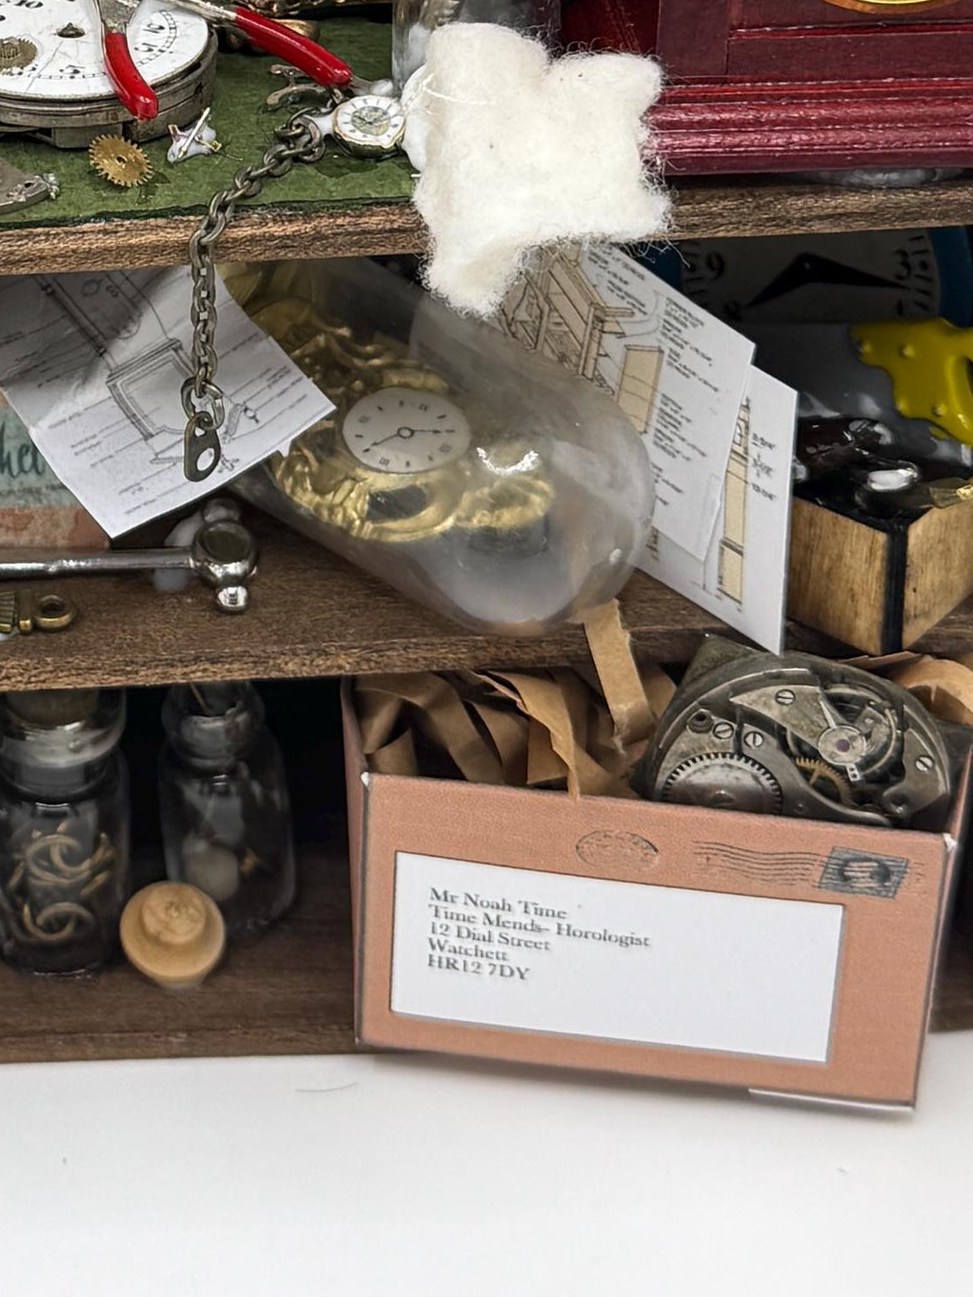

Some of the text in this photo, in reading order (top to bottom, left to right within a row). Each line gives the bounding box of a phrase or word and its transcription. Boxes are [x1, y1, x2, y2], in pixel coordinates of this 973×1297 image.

[429, 887, 569, 920] Mr Noah Time
[428, 904, 651, 949] Time Mends- Horologist
[430, 921, 552, 952] 12 Dial Street
[427, 937, 510, 962] Watchett
[427, 953, 532, 982] HR12 7DY
